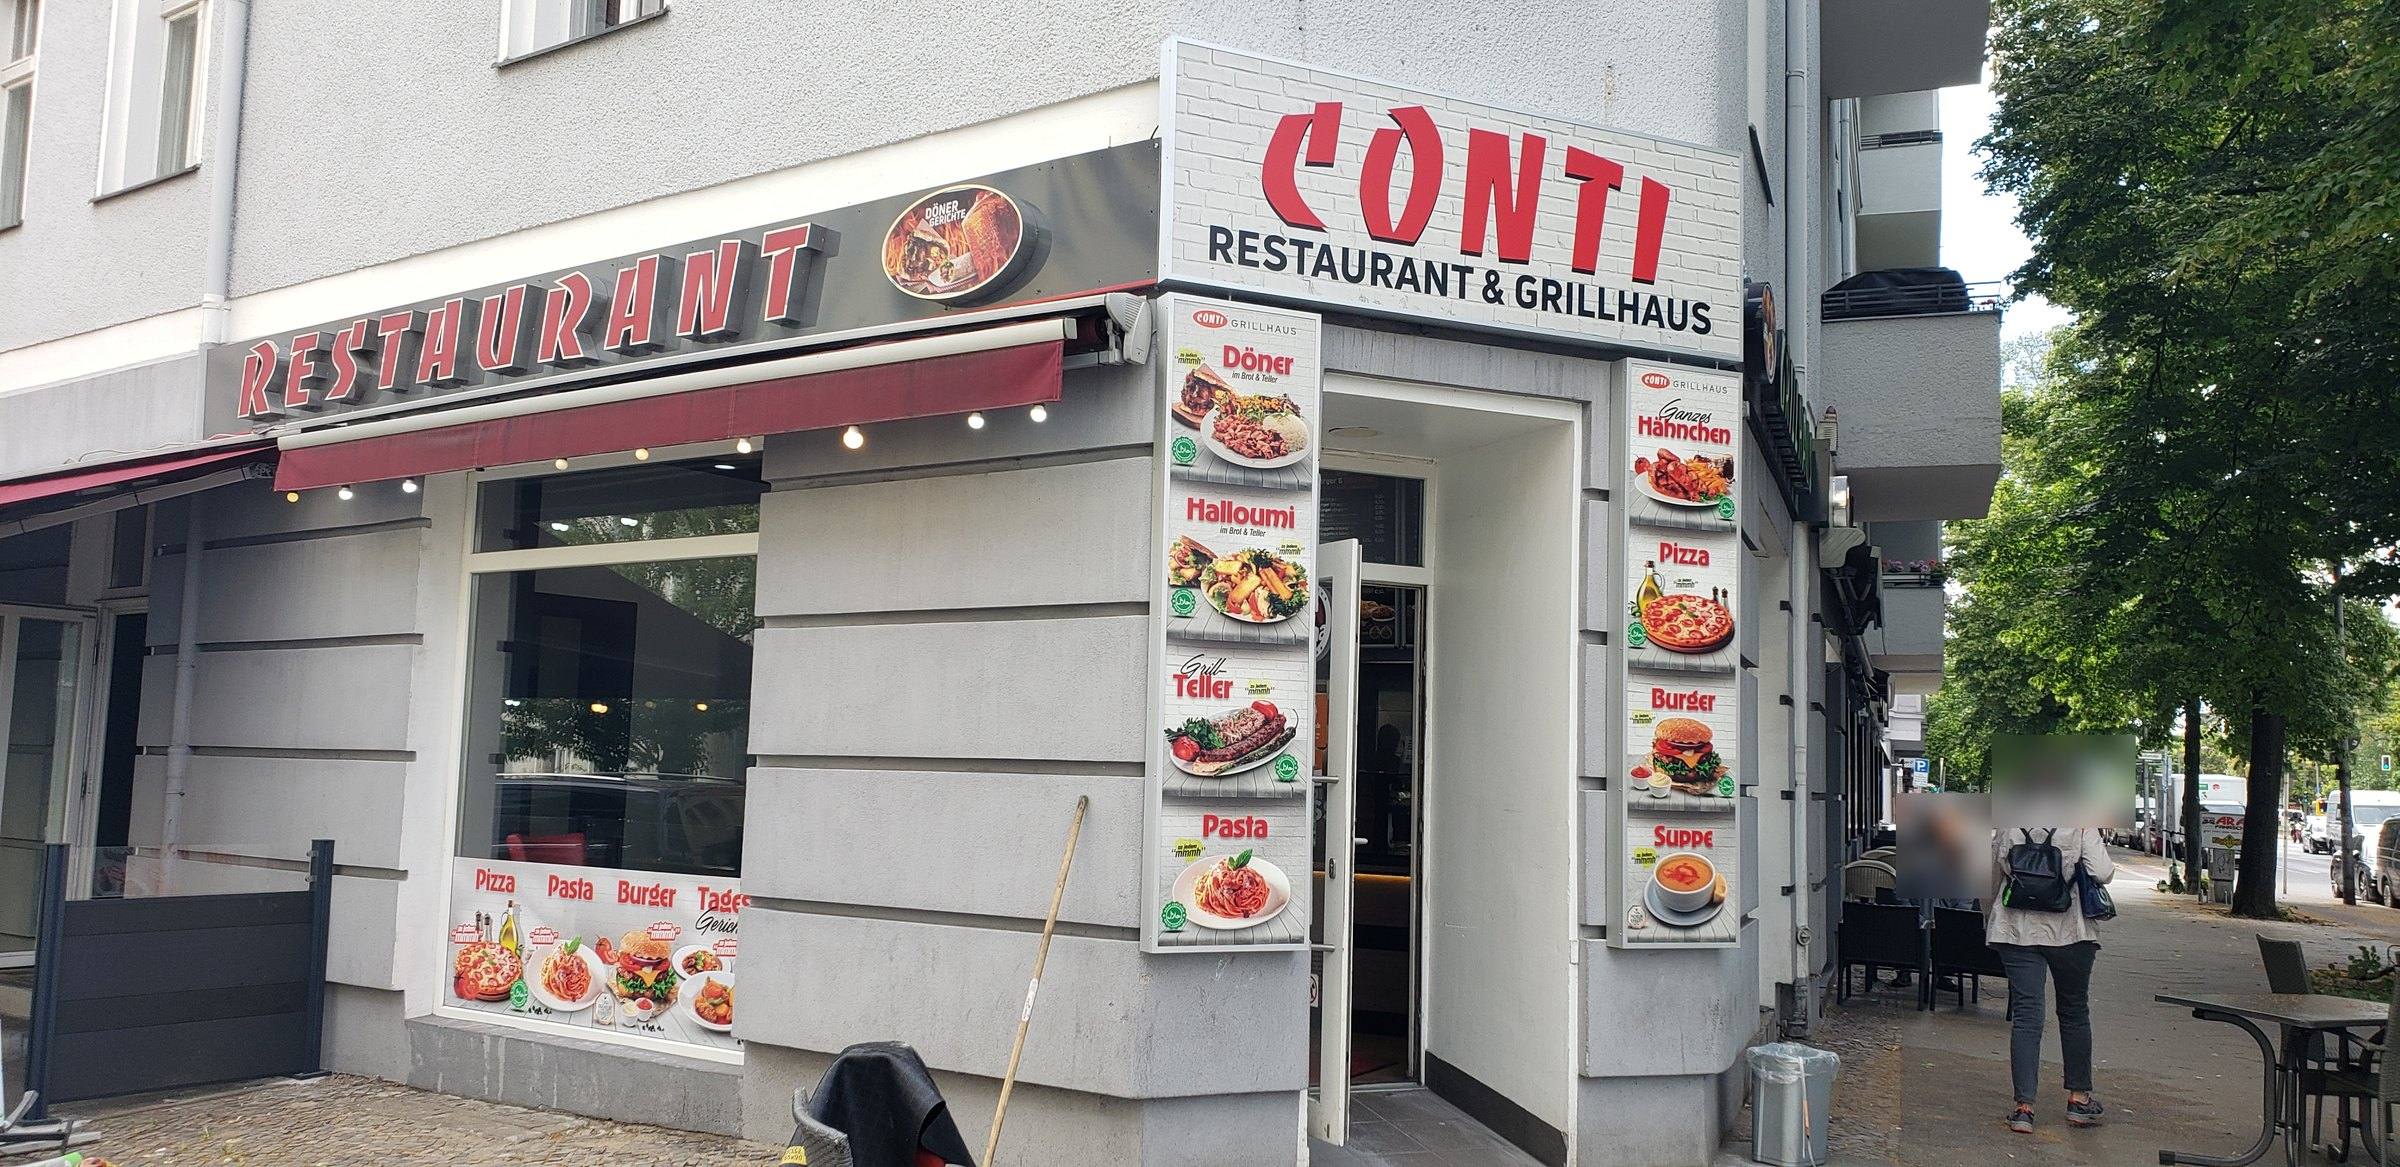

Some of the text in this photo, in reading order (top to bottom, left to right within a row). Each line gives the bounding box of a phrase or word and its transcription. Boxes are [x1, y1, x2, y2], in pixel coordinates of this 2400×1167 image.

[1262, 102, 1670, 284] CONTI
[925, 200, 959, 219] DÖNER
[930, 208, 967, 226] GERICHTE
[1209, 225, 1711, 335] RESTAURANT & GRILLHAUS
[238, 222, 811, 418] RESTAURANT
[1197, 312, 1297, 335] CONTI GRILLHAUS
[1223, 345, 1294, 375] Döner
[1231, 371, 1279, 383] im Brot & Teller
[1644, 375, 1728, 395] CONTI GRILLHAUS
[1659, 398, 1712, 424] Ganzes
[1638, 415, 1731, 445] Hähnchen
[1187, 497, 1295, 528] Halloumi
[1219, 526, 1266, 538] im Brot & Teller
[1660, 542, 1710, 567] Pizza
[1173, 673, 1233, 699] Teller
[1652, 687, 1716, 711] Burger
[1203, 814, 1268, 838] Pasta
[1654, 824, 1713, 848] Suppe
[476, 868, 515, 893] Pizza
[549, 874, 593, 900] Pasta
[618, 880, 676, 907] Burger
